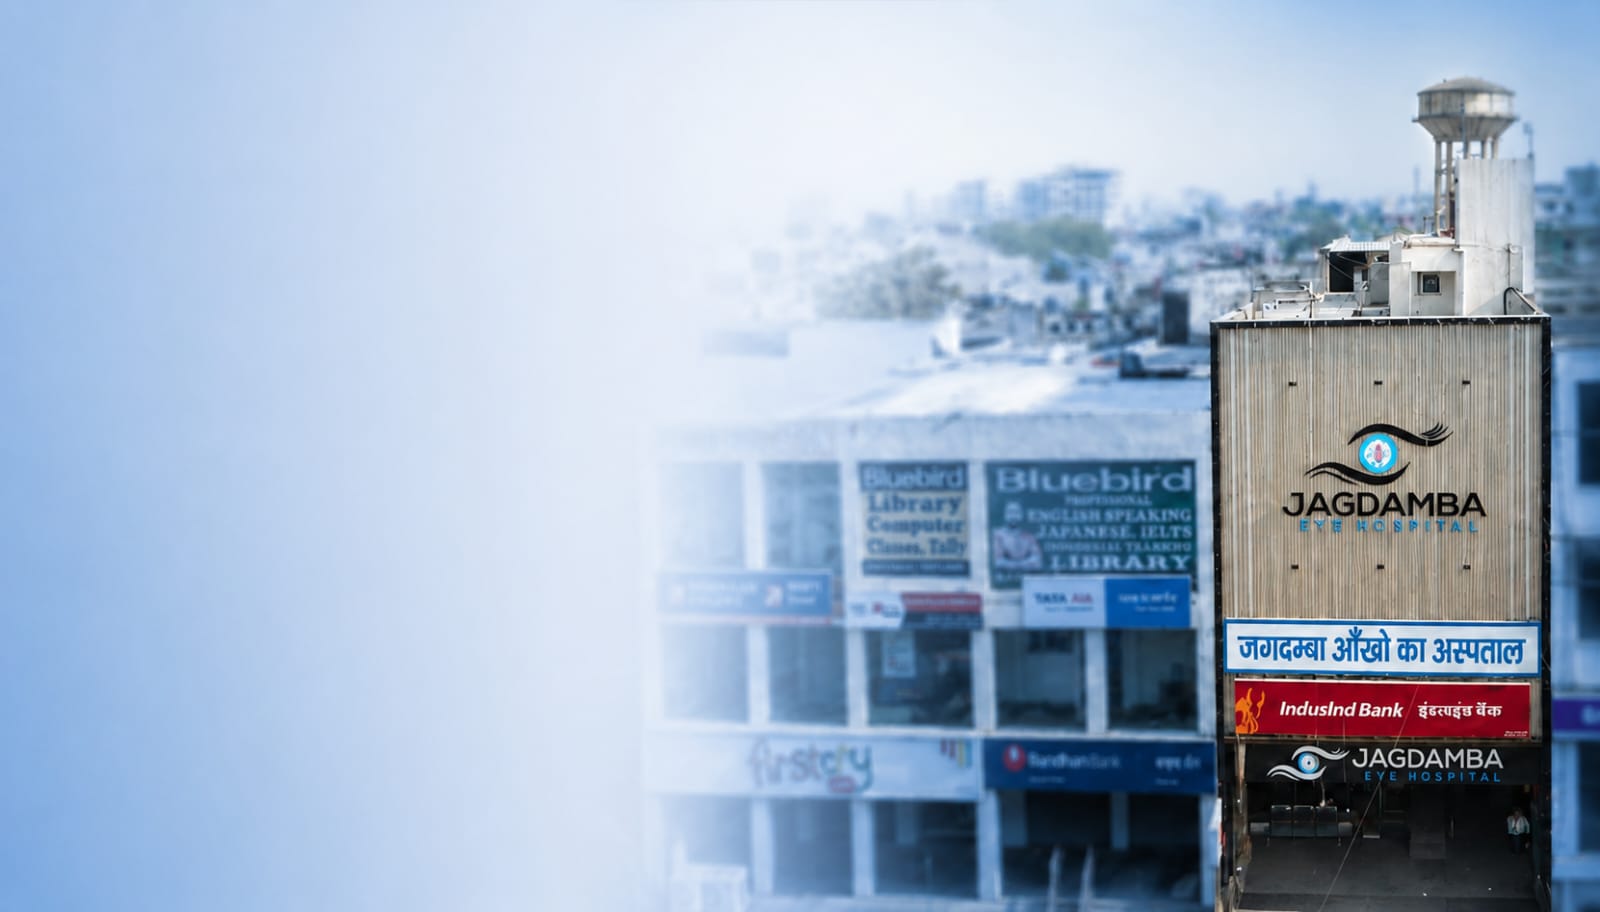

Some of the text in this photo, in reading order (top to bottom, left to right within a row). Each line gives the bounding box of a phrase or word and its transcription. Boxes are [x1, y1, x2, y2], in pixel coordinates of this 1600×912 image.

[997, 466, 1193, 492] Bluebird
[868, 494, 963, 516] Library
[1282, 492, 1487, 517] JAGDAMBA
[1027, 508, 1192, 522] ENGLISH SPEAKING
[866, 515, 964, 537] Computer
[1141, 524, 1193, 538] IELTS
[1299, 519, 1479, 533] EYE HOSPITAL
[1050, 555, 1190, 570] LIBRARY
[1034, 592, 1067, 604] TATA
[1237, 635, 1328, 662] जगदम्बा
[1396, 637, 1426, 663] का
[1431, 637, 1527, 665] अस्पताल
[1279, 701, 1403, 718] IndusInd Bank
[1352, 748, 1504, 770] JAGDAMBA
[1364, 771, 1501, 783] EYE HOSPITAL
